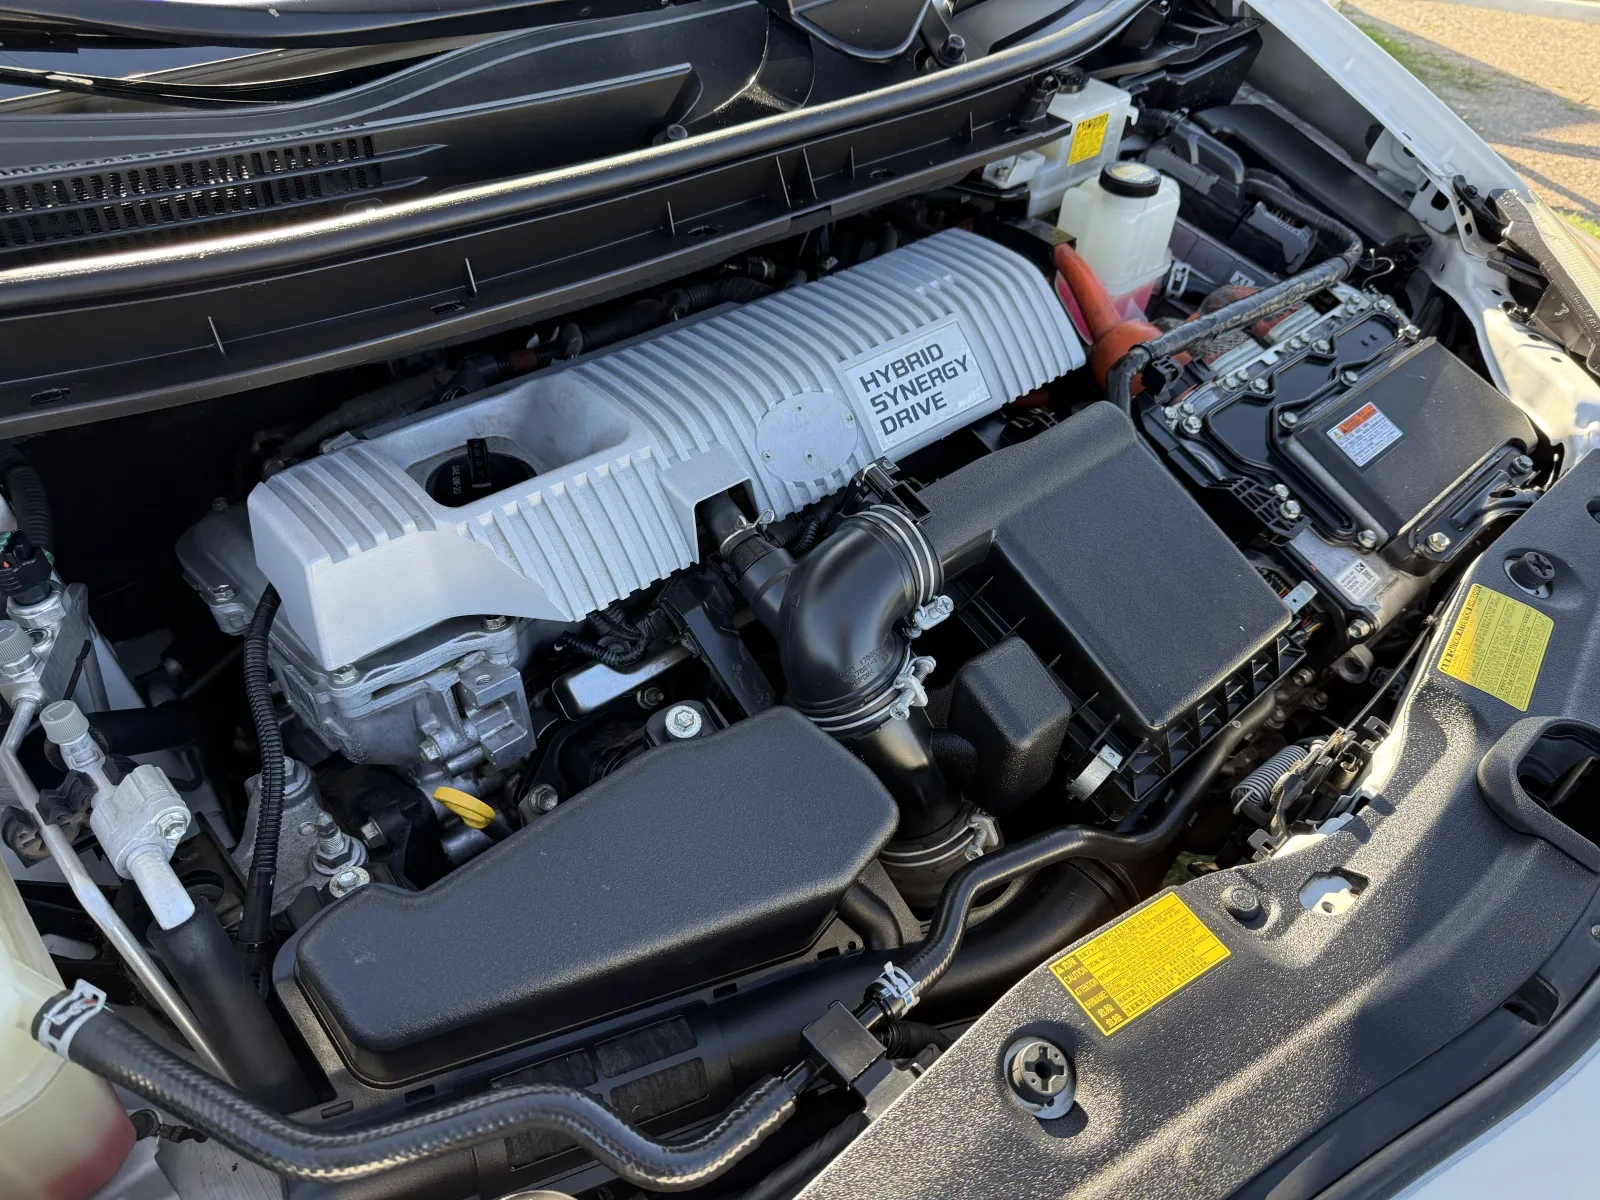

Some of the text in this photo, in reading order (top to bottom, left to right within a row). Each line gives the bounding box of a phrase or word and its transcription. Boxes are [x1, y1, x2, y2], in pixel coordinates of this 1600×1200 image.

[859, 343, 943, 393] HYBRID
[870, 354, 968, 415] SYNERGY
[880, 391, 947, 436] DRIVE
[1063, 966, 1088, 984] CAUTION
